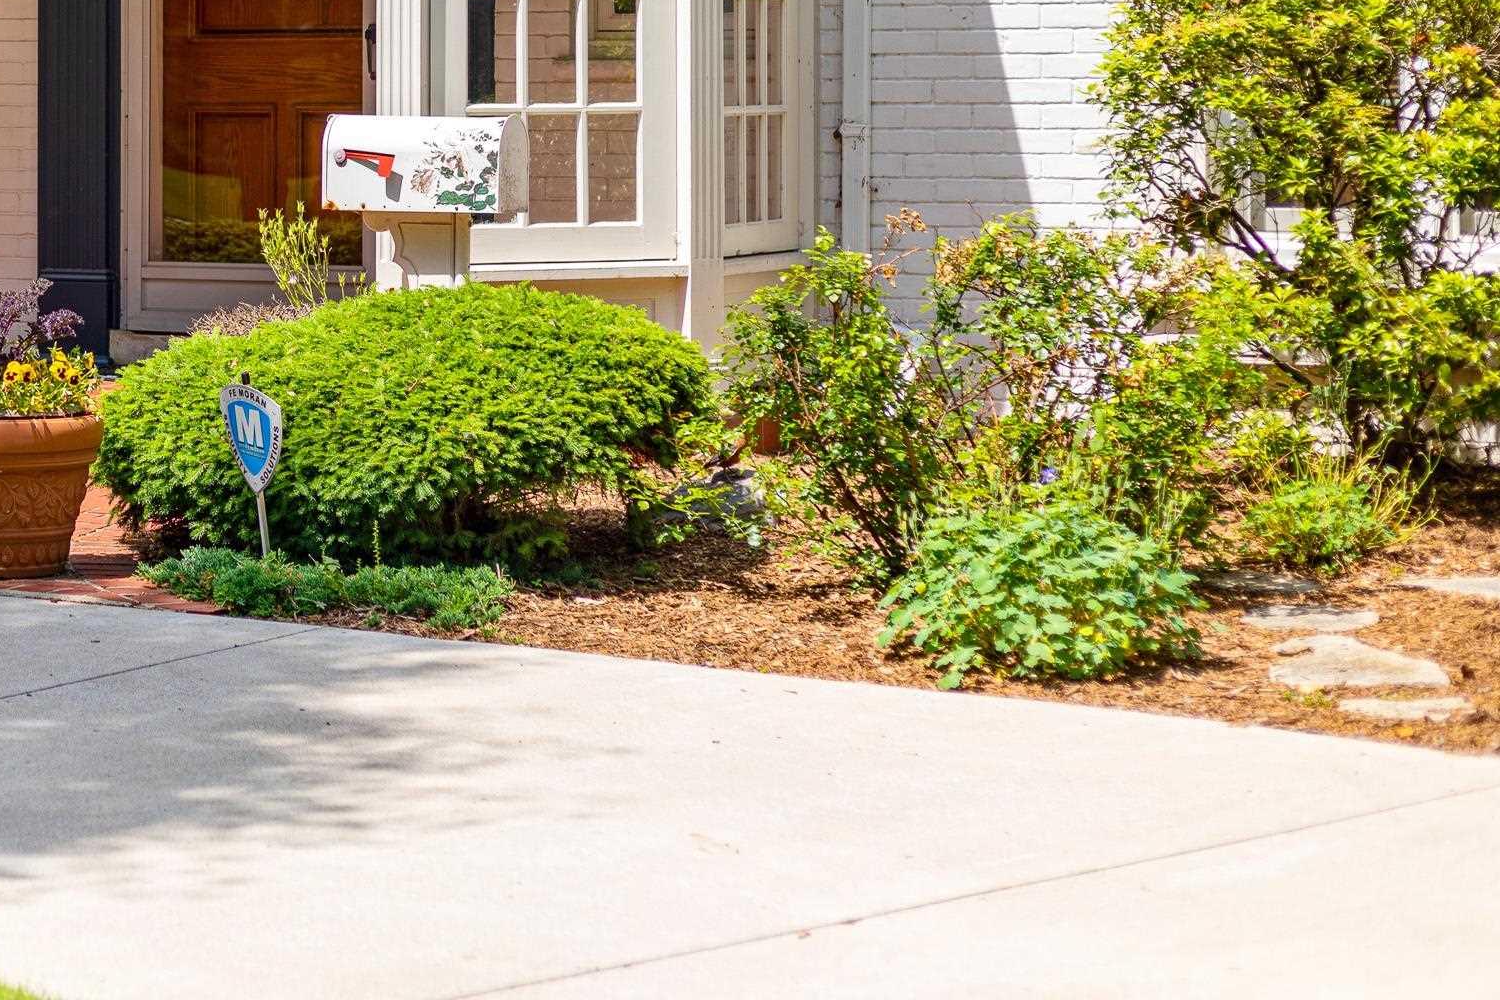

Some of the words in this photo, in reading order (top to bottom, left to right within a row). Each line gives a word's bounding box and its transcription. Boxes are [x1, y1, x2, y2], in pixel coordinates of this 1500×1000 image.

[228, 389, 236, 398] FE
[238, 389, 267, 408] MORAN
[235, 404, 264, 449] M
[261, 426, 280, 484] SOLUTIONS
